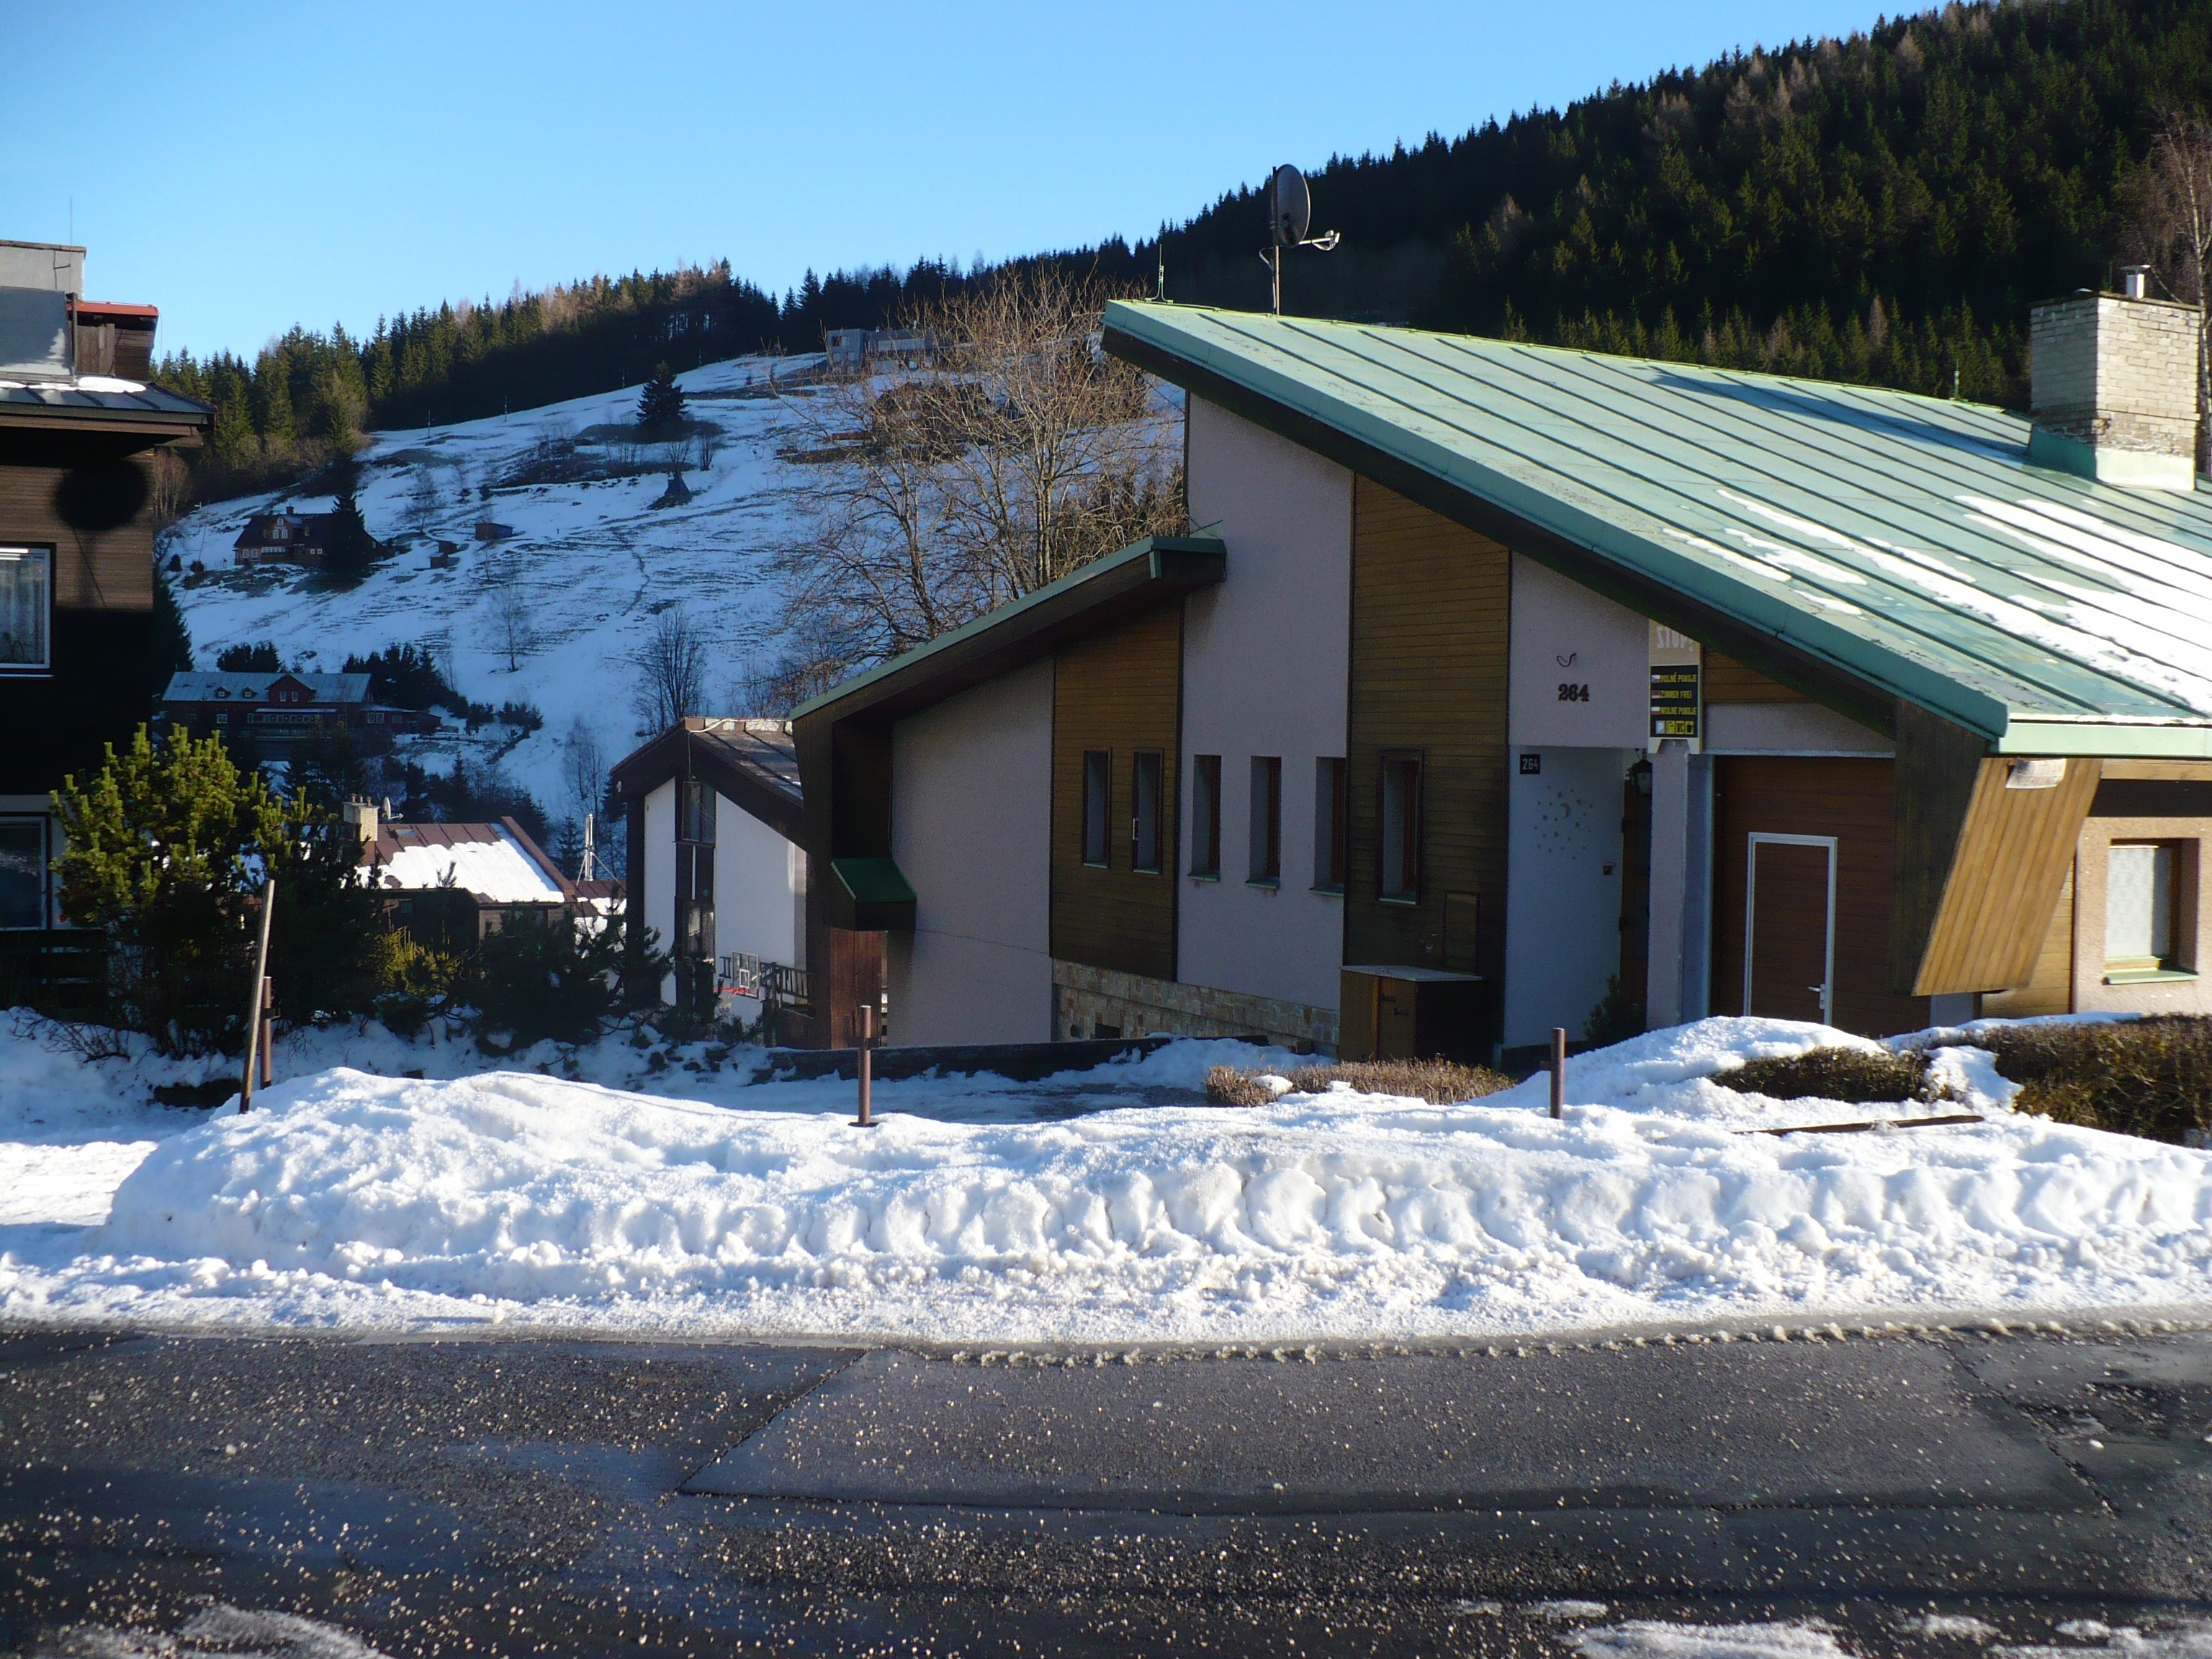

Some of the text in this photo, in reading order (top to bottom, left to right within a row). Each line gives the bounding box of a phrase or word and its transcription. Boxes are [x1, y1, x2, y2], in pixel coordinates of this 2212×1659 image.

[1678, 674, 1696, 683] POKOJE
[1557, 683, 1589, 702] 264
[1678, 706, 1696, 715] POKOJE
[1521, 758, 1539, 770] 264
